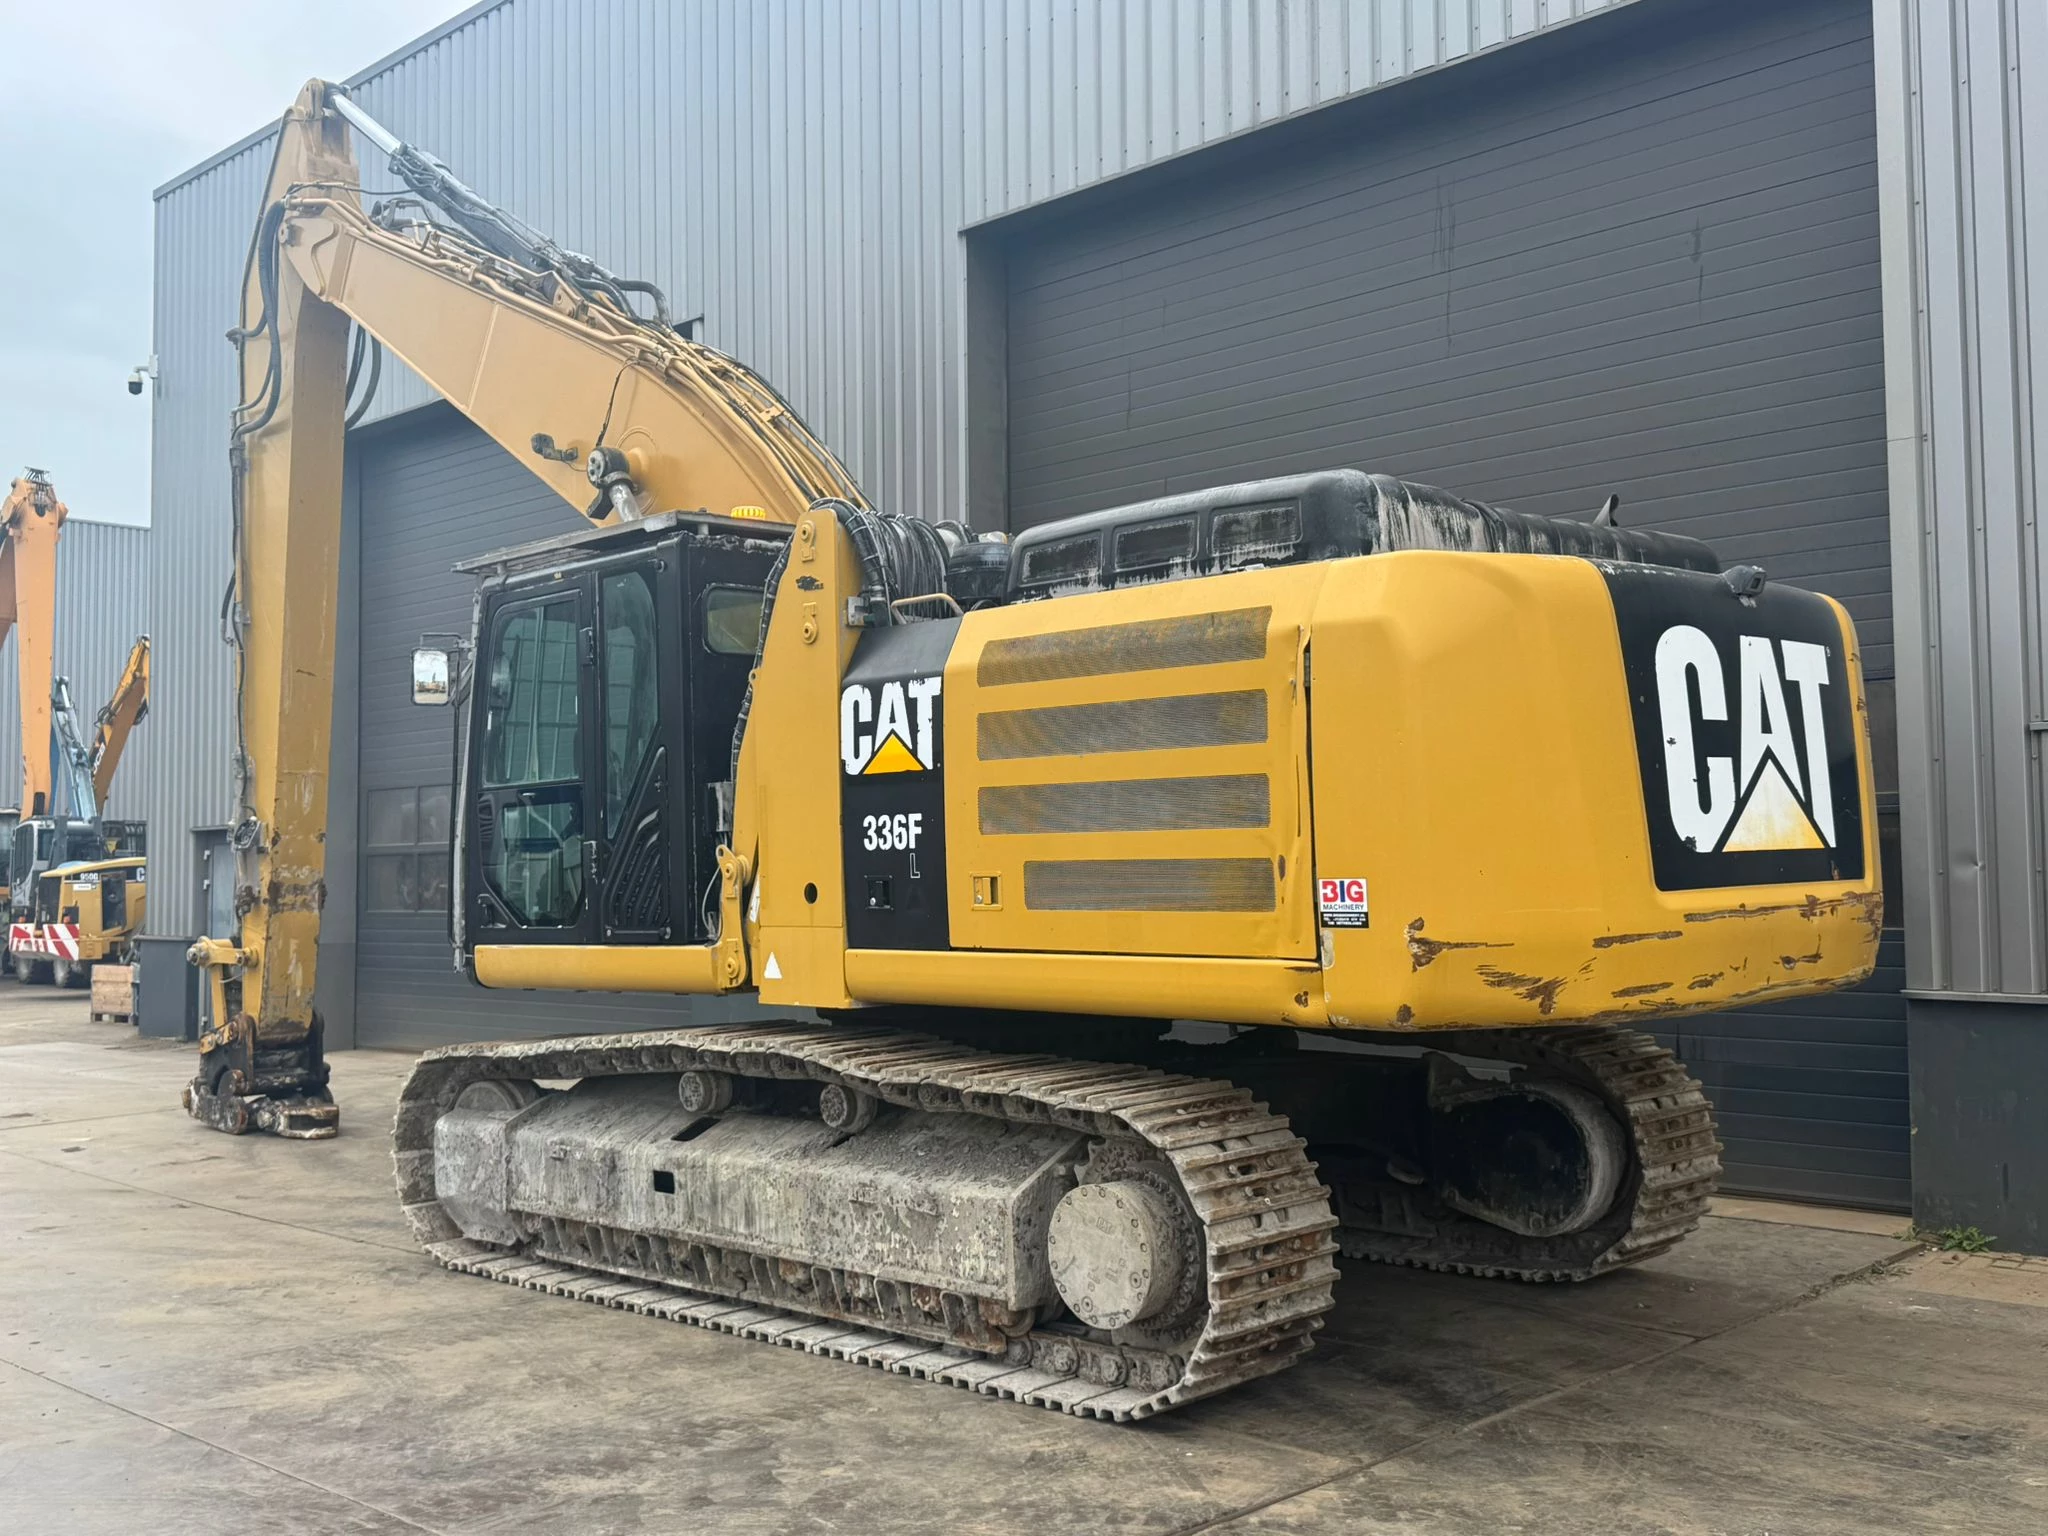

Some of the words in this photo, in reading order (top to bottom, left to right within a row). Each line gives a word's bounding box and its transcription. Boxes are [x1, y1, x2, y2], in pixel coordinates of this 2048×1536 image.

[841, 676, 942, 776] CAT
[1655, 625, 1837, 853] CAT
[863, 813, 922, 851] 336F
[910, 852, 921, 878] L
[1322, 880, 1364, 903] BIG
